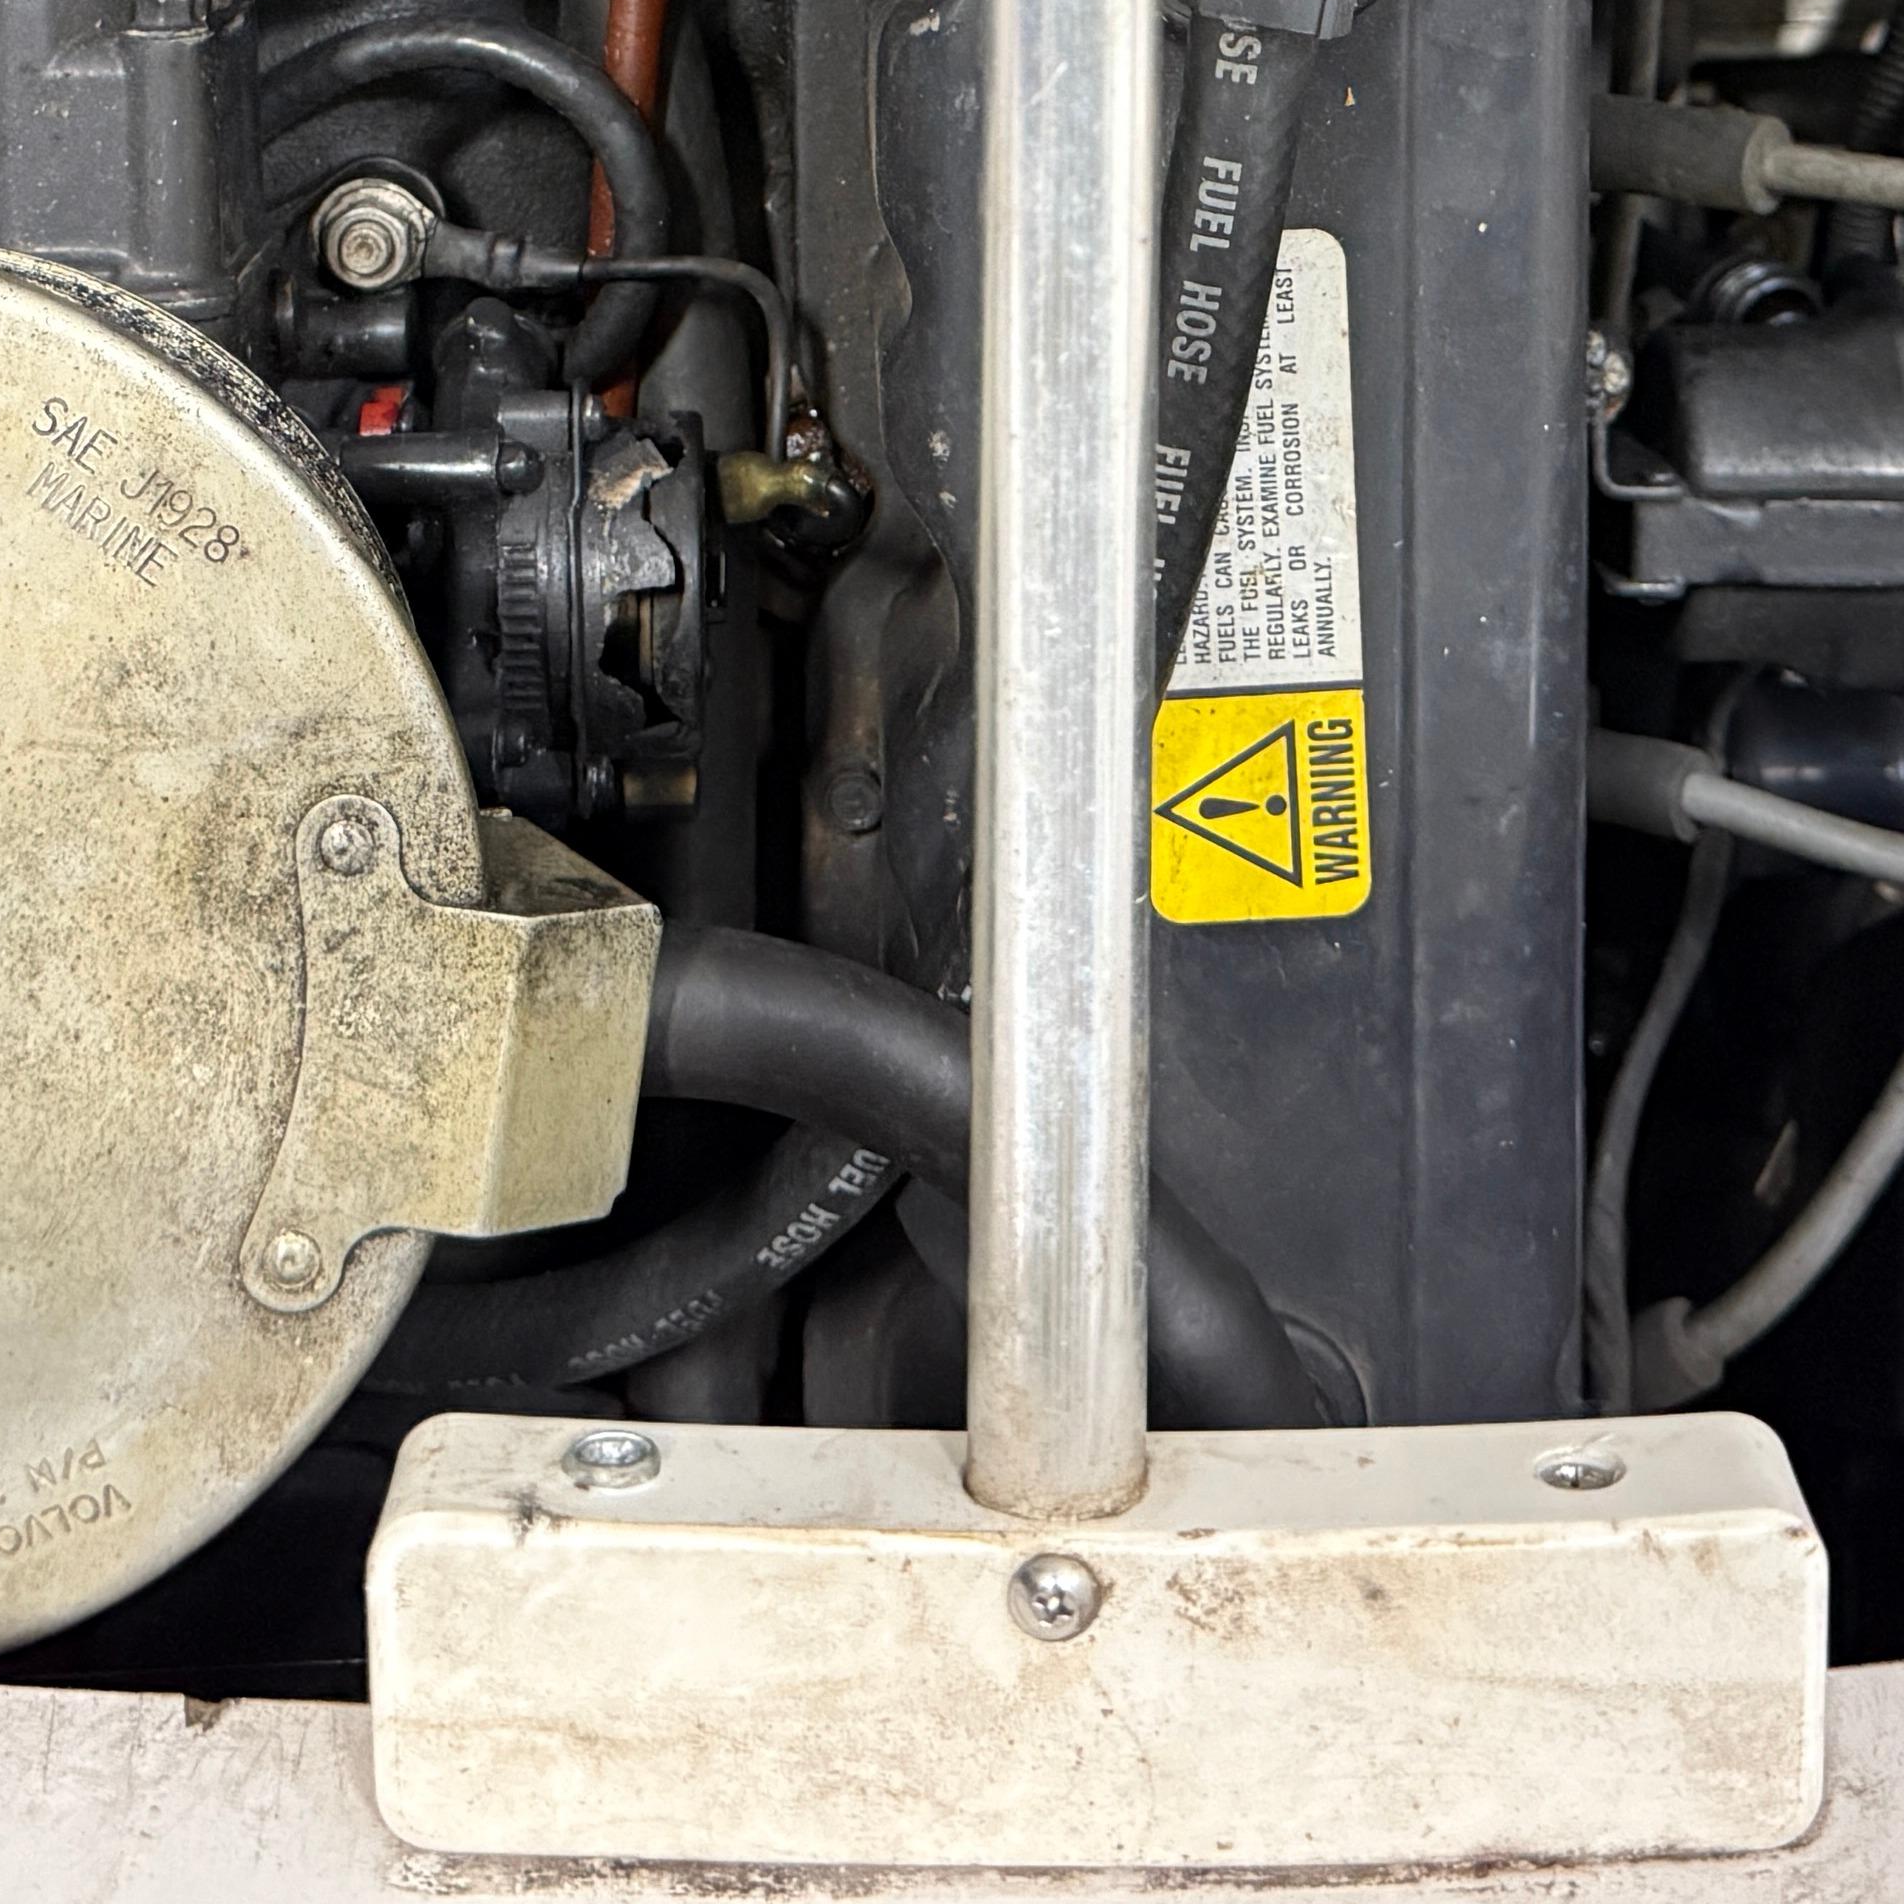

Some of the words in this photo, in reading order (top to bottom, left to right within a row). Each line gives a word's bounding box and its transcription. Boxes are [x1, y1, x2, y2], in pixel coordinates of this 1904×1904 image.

[1215, 30, 1262, 85] SE
[1189, 156, 1242, 252] FUEL
[1275, 267, 1295, 324] LEAST
[1167, 280, 1222, 384] HOSE
[1279, 352, 1297, 374] AT
[1256, 398, 1276, 445] FUEL
[32, 397, 118, 475] SAE
[120, 469, 240, 563] J1928
[1282, 403, 1304, 516] CORROSION
[26, 461, 179, 587] MARINE
[1234, 467, 1257, 551] SYSTEM.
[1259, 454, 1280, 538] EXAMINE
[1214, 551, 1233, 589] CAN
[1288, 545, 1306, 571] OR
[1239, 569, 1259, 612] FUEL
[1261, 548, 1287, 660] REGULARLY.
[1313, 556, 1337, 657] ANNUALLY.
[1216, 604, 1237, 663] FUELS
[1242, 626, 1262, 662] THE
[1290, 599, 1312, 658] LEAKS
[1307, 718, 1360, 885] WARNING
[828, 1148, 891, 1197] UEL
[756, 1203, 841, 1271] HOSE
[24, 1437, 107, 1494] P/N
